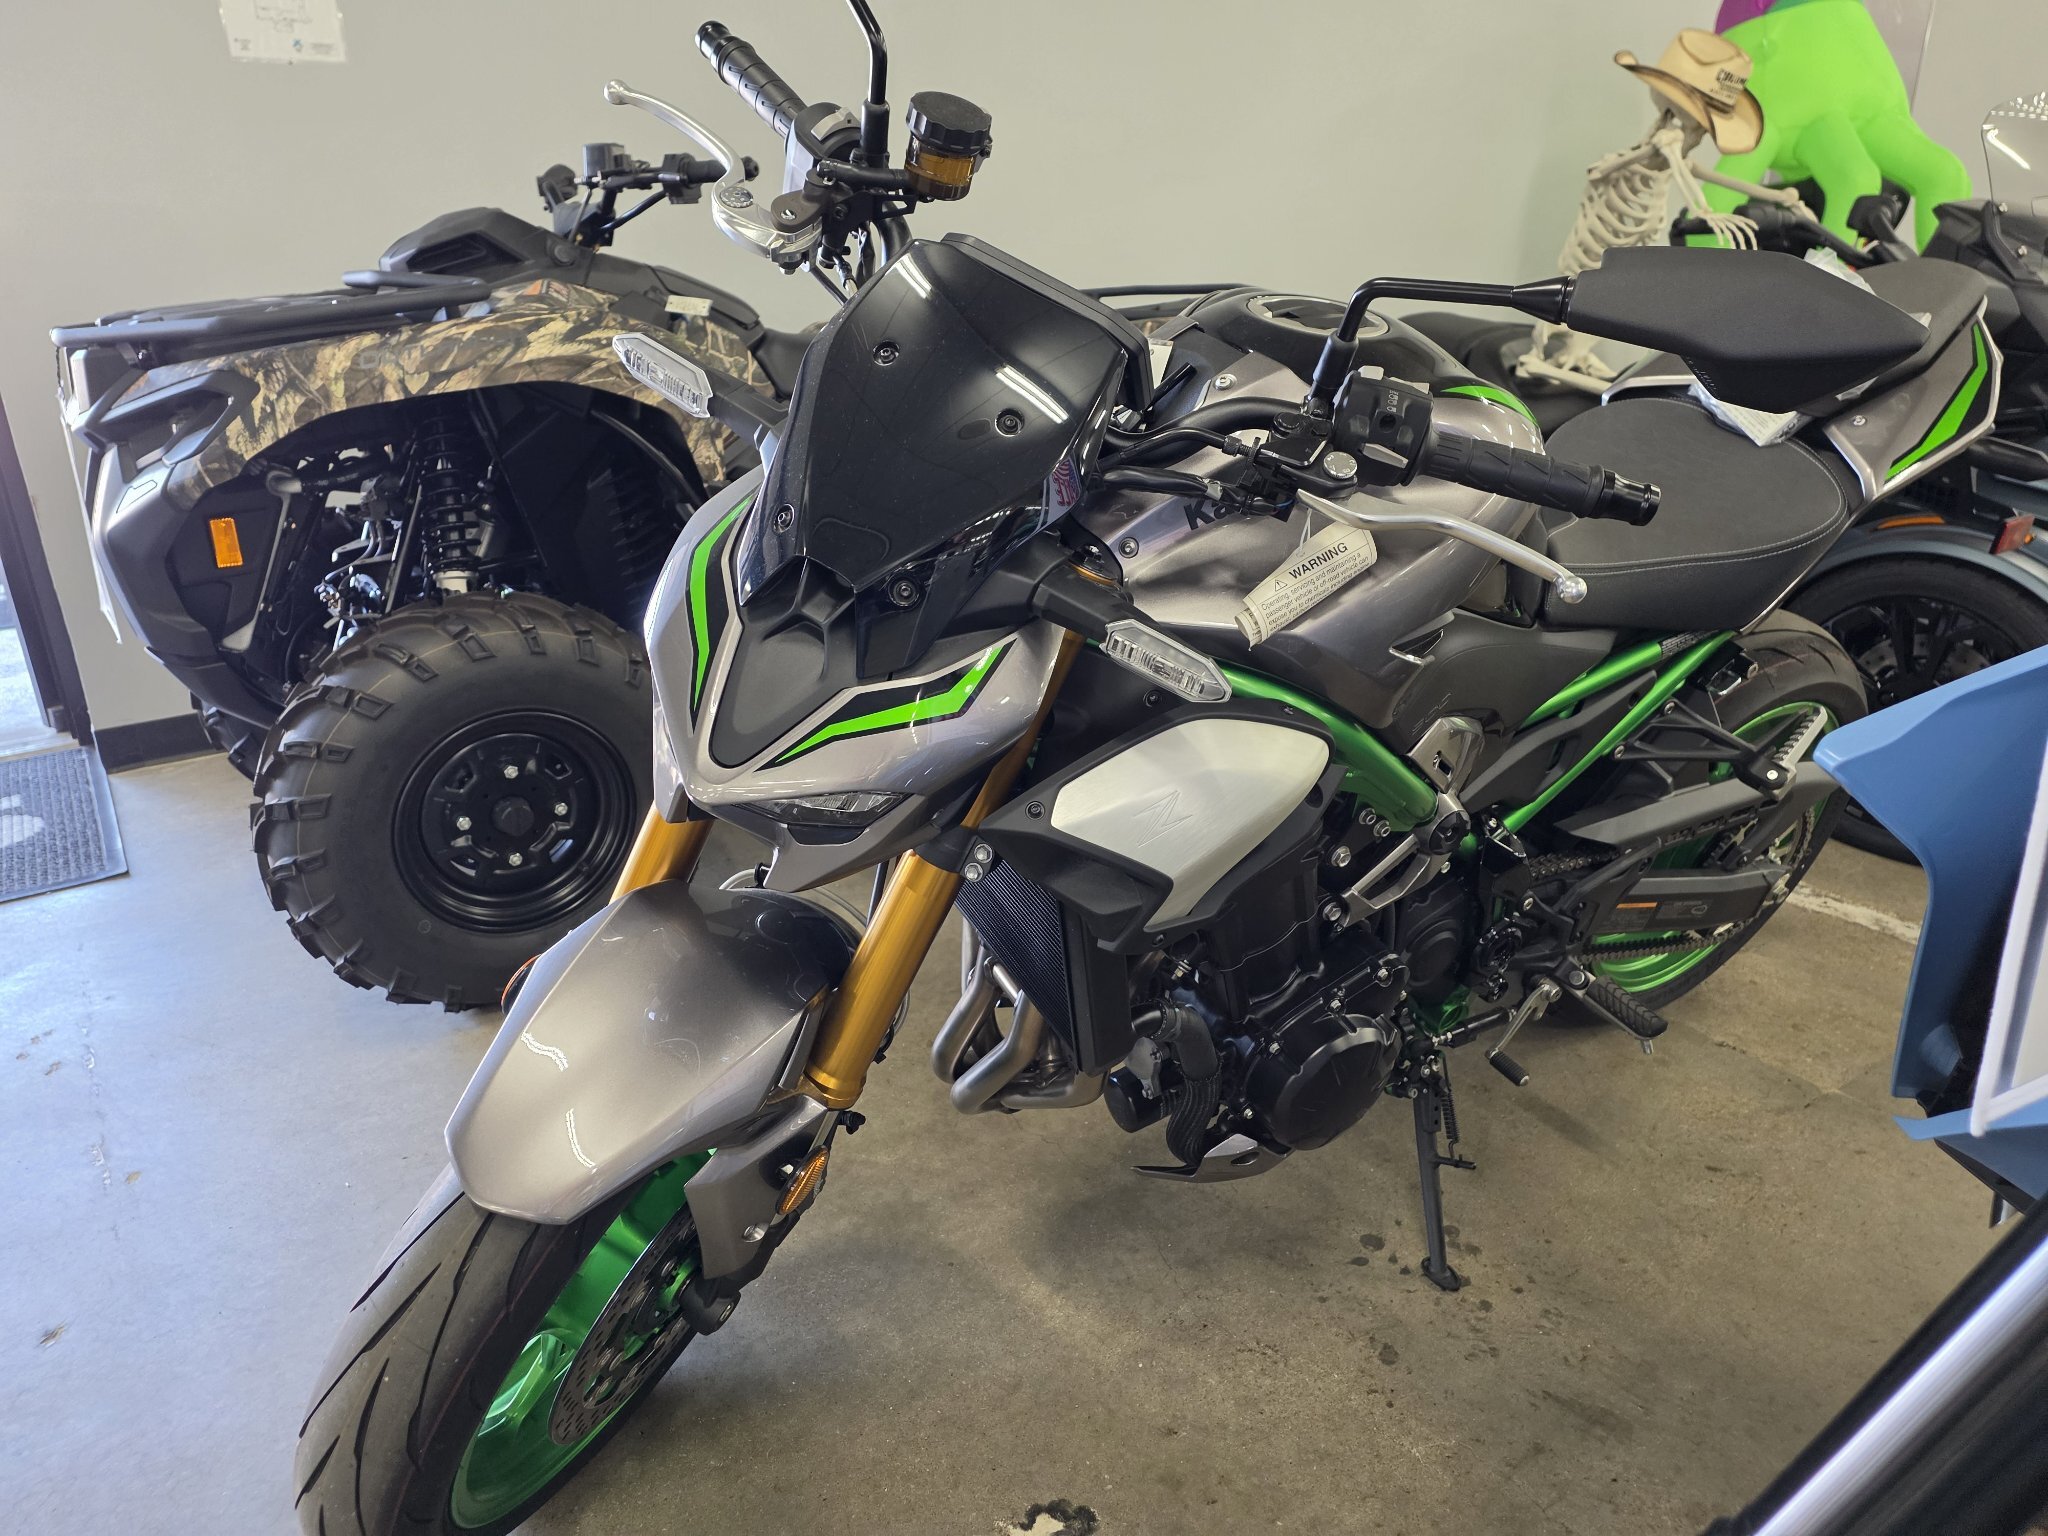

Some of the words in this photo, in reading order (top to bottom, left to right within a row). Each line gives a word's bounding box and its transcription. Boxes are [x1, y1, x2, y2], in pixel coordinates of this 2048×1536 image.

[1261, 592, 1290, 611] Operating,
[1291, 578, 1316, 596] servicing
[1315, 571, 1327, 581] and
[1326, 555, 1357, 576] maintaining
[1265, 599, 1294, 619] passenger
[1293, 588, 1313, 602] vehicle
[1313, 584, 1319, 592] or
[1319, 572, 1340, 588] off-road
[1340, 563, 1359, 577] vehicle
[1358, 556, 1369, 565] can
[1288, 542, 1348, 579] WARNING
[1268, 611, 1288, 625] expose
[1288, 605, 1298, 615] you
[1304, 586, 1330, 604] chemicals
[1330, 572, 1354, 590] including
